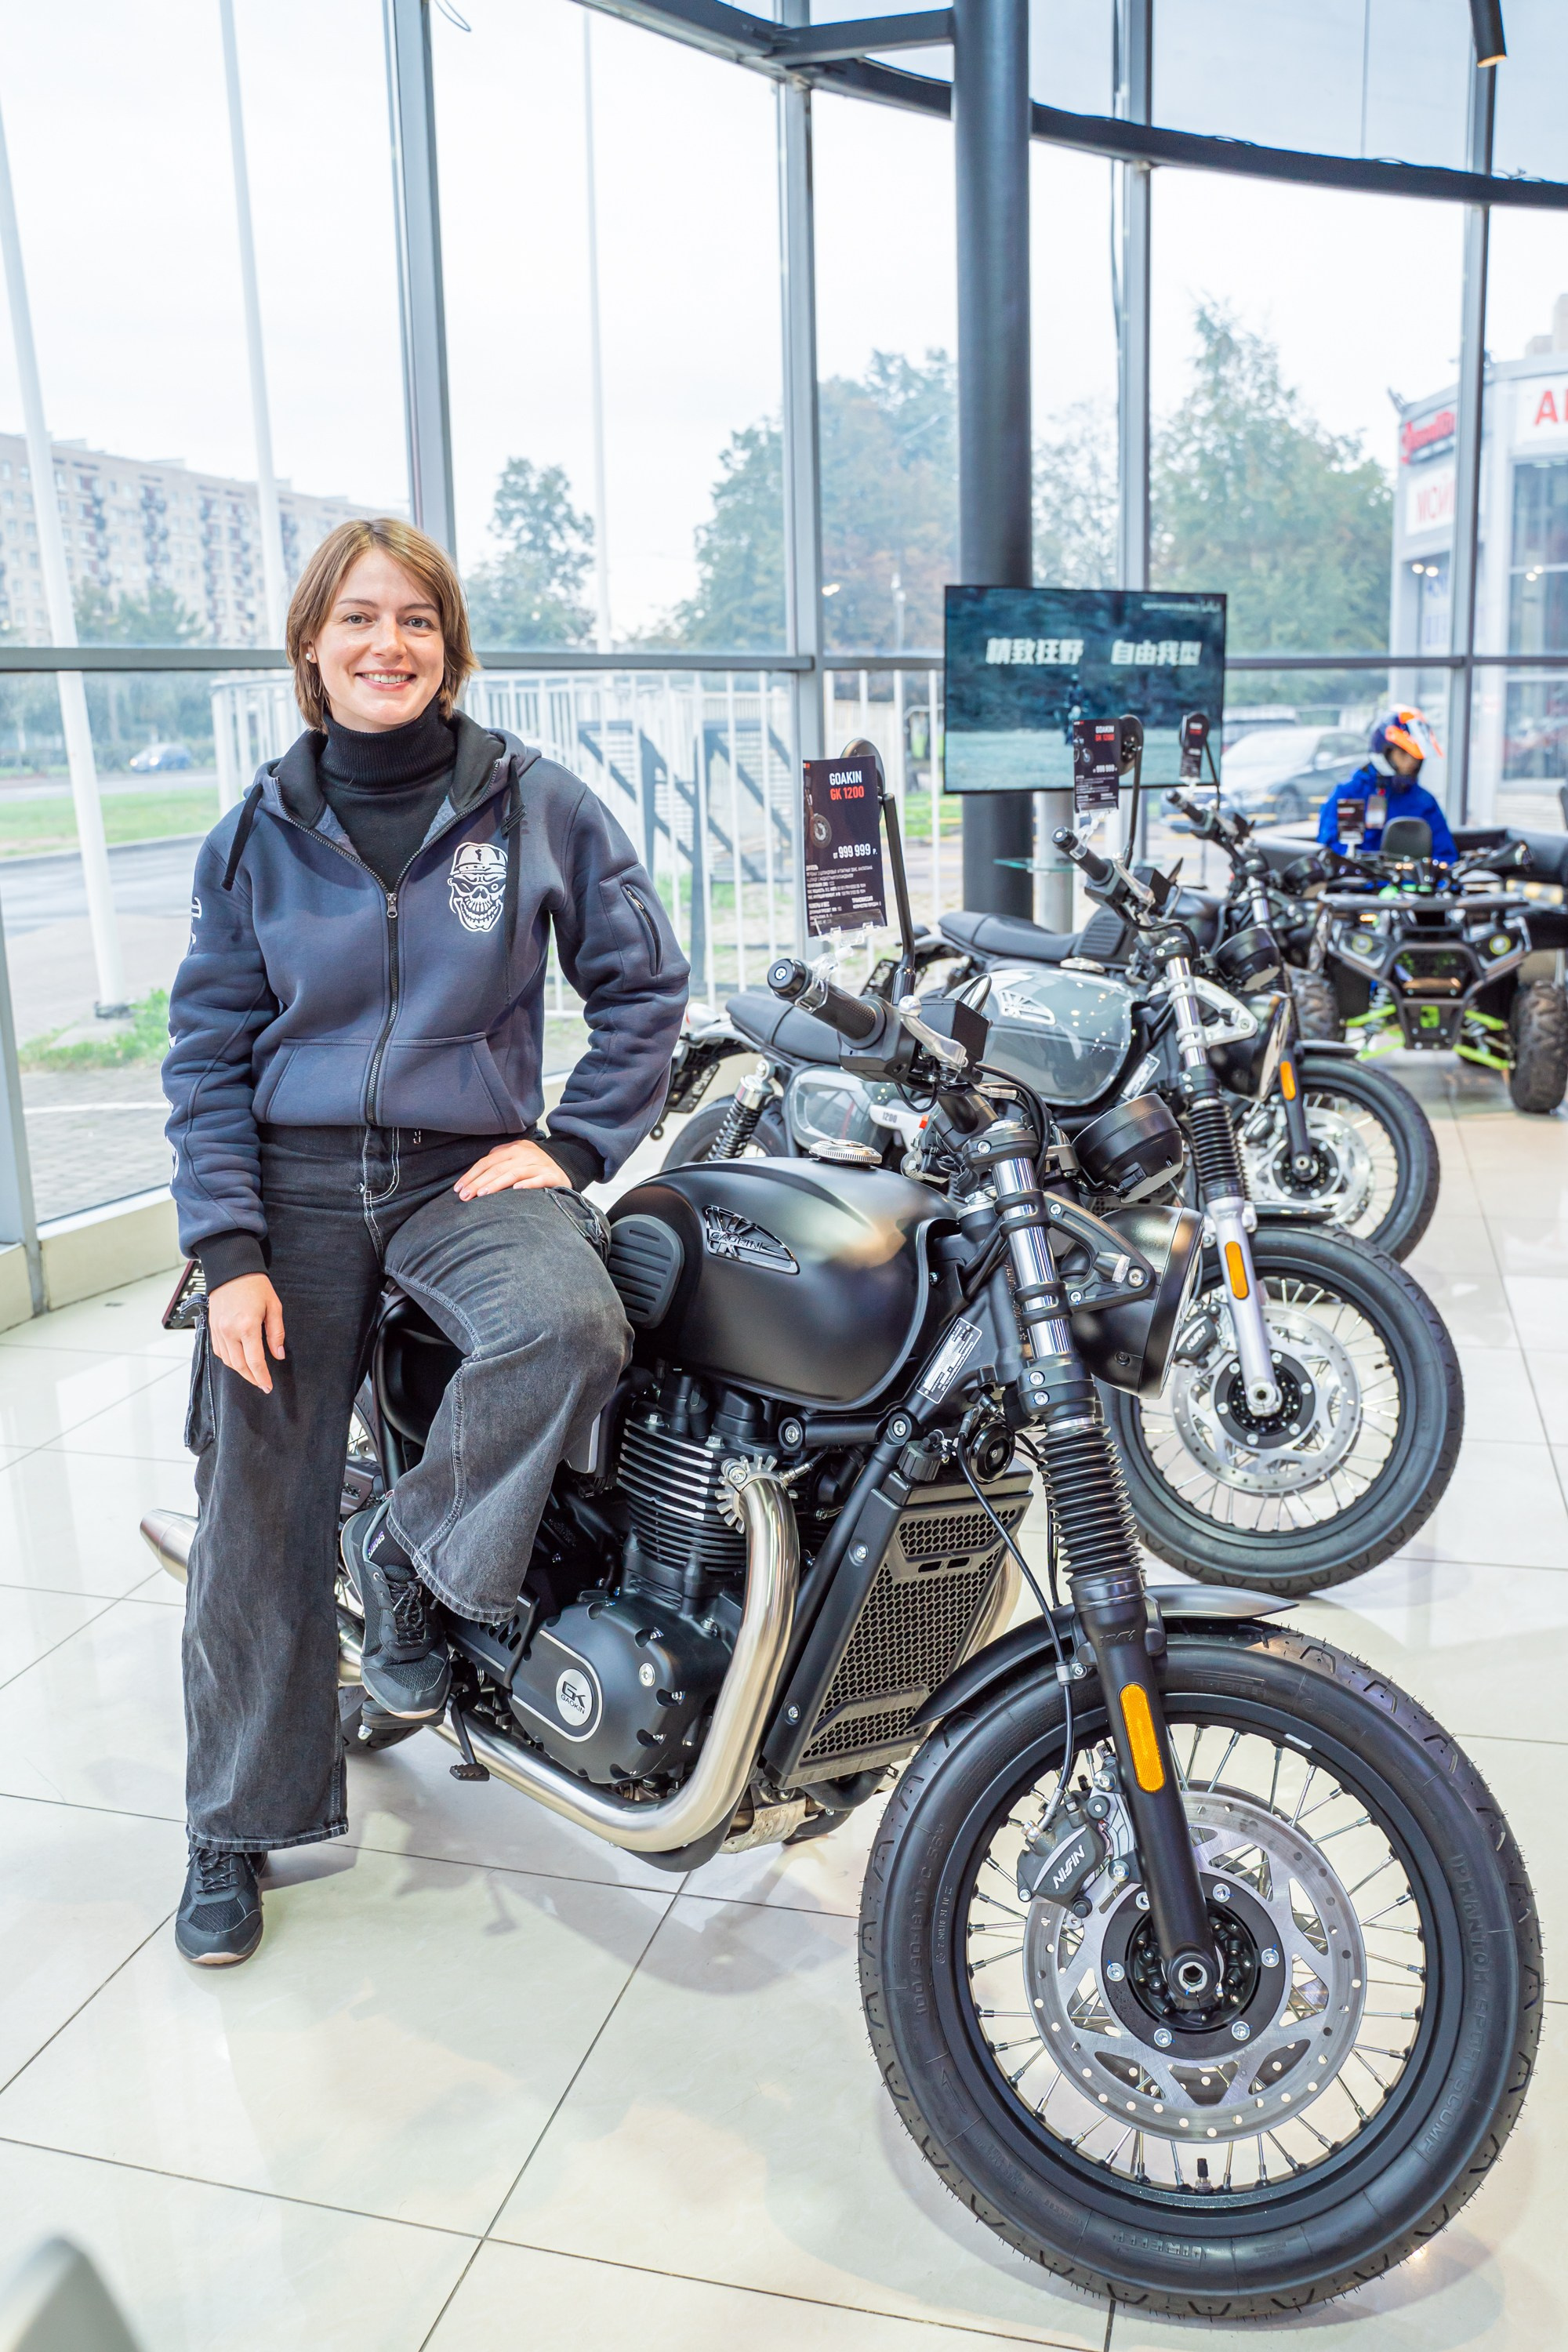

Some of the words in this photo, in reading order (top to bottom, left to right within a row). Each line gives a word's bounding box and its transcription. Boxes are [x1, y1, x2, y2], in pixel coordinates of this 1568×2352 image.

[829, 771, 862, 786] GOAKIN
[830, 788, 842, 800] GK
[843, 786, 865, 799] 1200
[838, 845, 853, 858] 999
[854, 843, 871, 857] 999
[882, 1111, 898, 1123] 1200
[710, 1232, 764, 1252] GAOKIN
[562, 1680, 586, 1709] GK
[561, 1693, 586, 1715] GAOKIN
[1052, 1844, 1085, 1889] NISSIN
